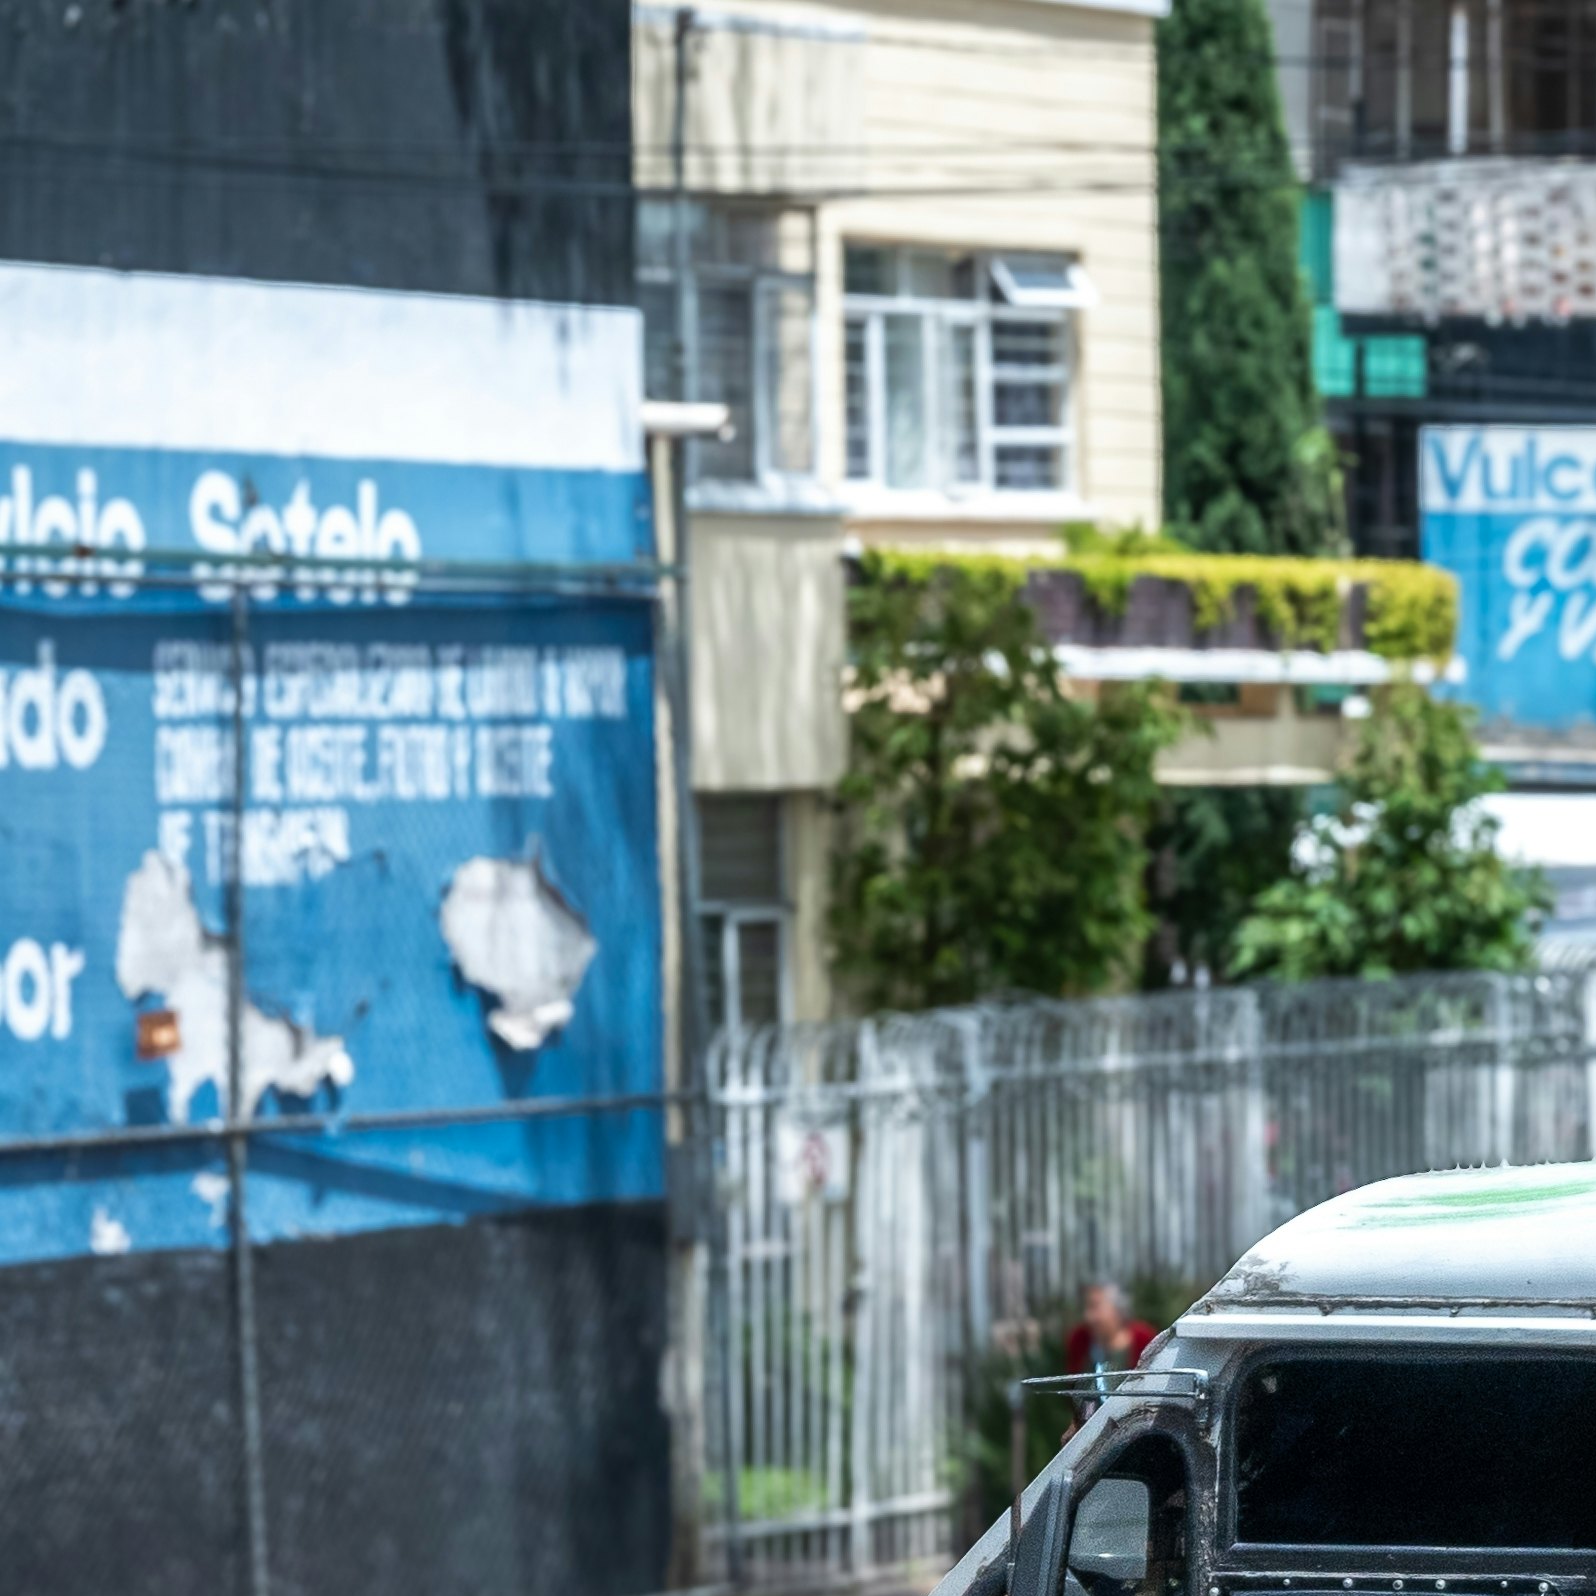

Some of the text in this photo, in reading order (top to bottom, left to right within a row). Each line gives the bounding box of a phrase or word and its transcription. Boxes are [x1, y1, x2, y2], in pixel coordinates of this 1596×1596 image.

[0, 464, 423, 606] icio Sotelo
[1497, 589, 1554, 663] Y
[0, 638, 107, 771] do
[0, 936, 86, 1042] or
